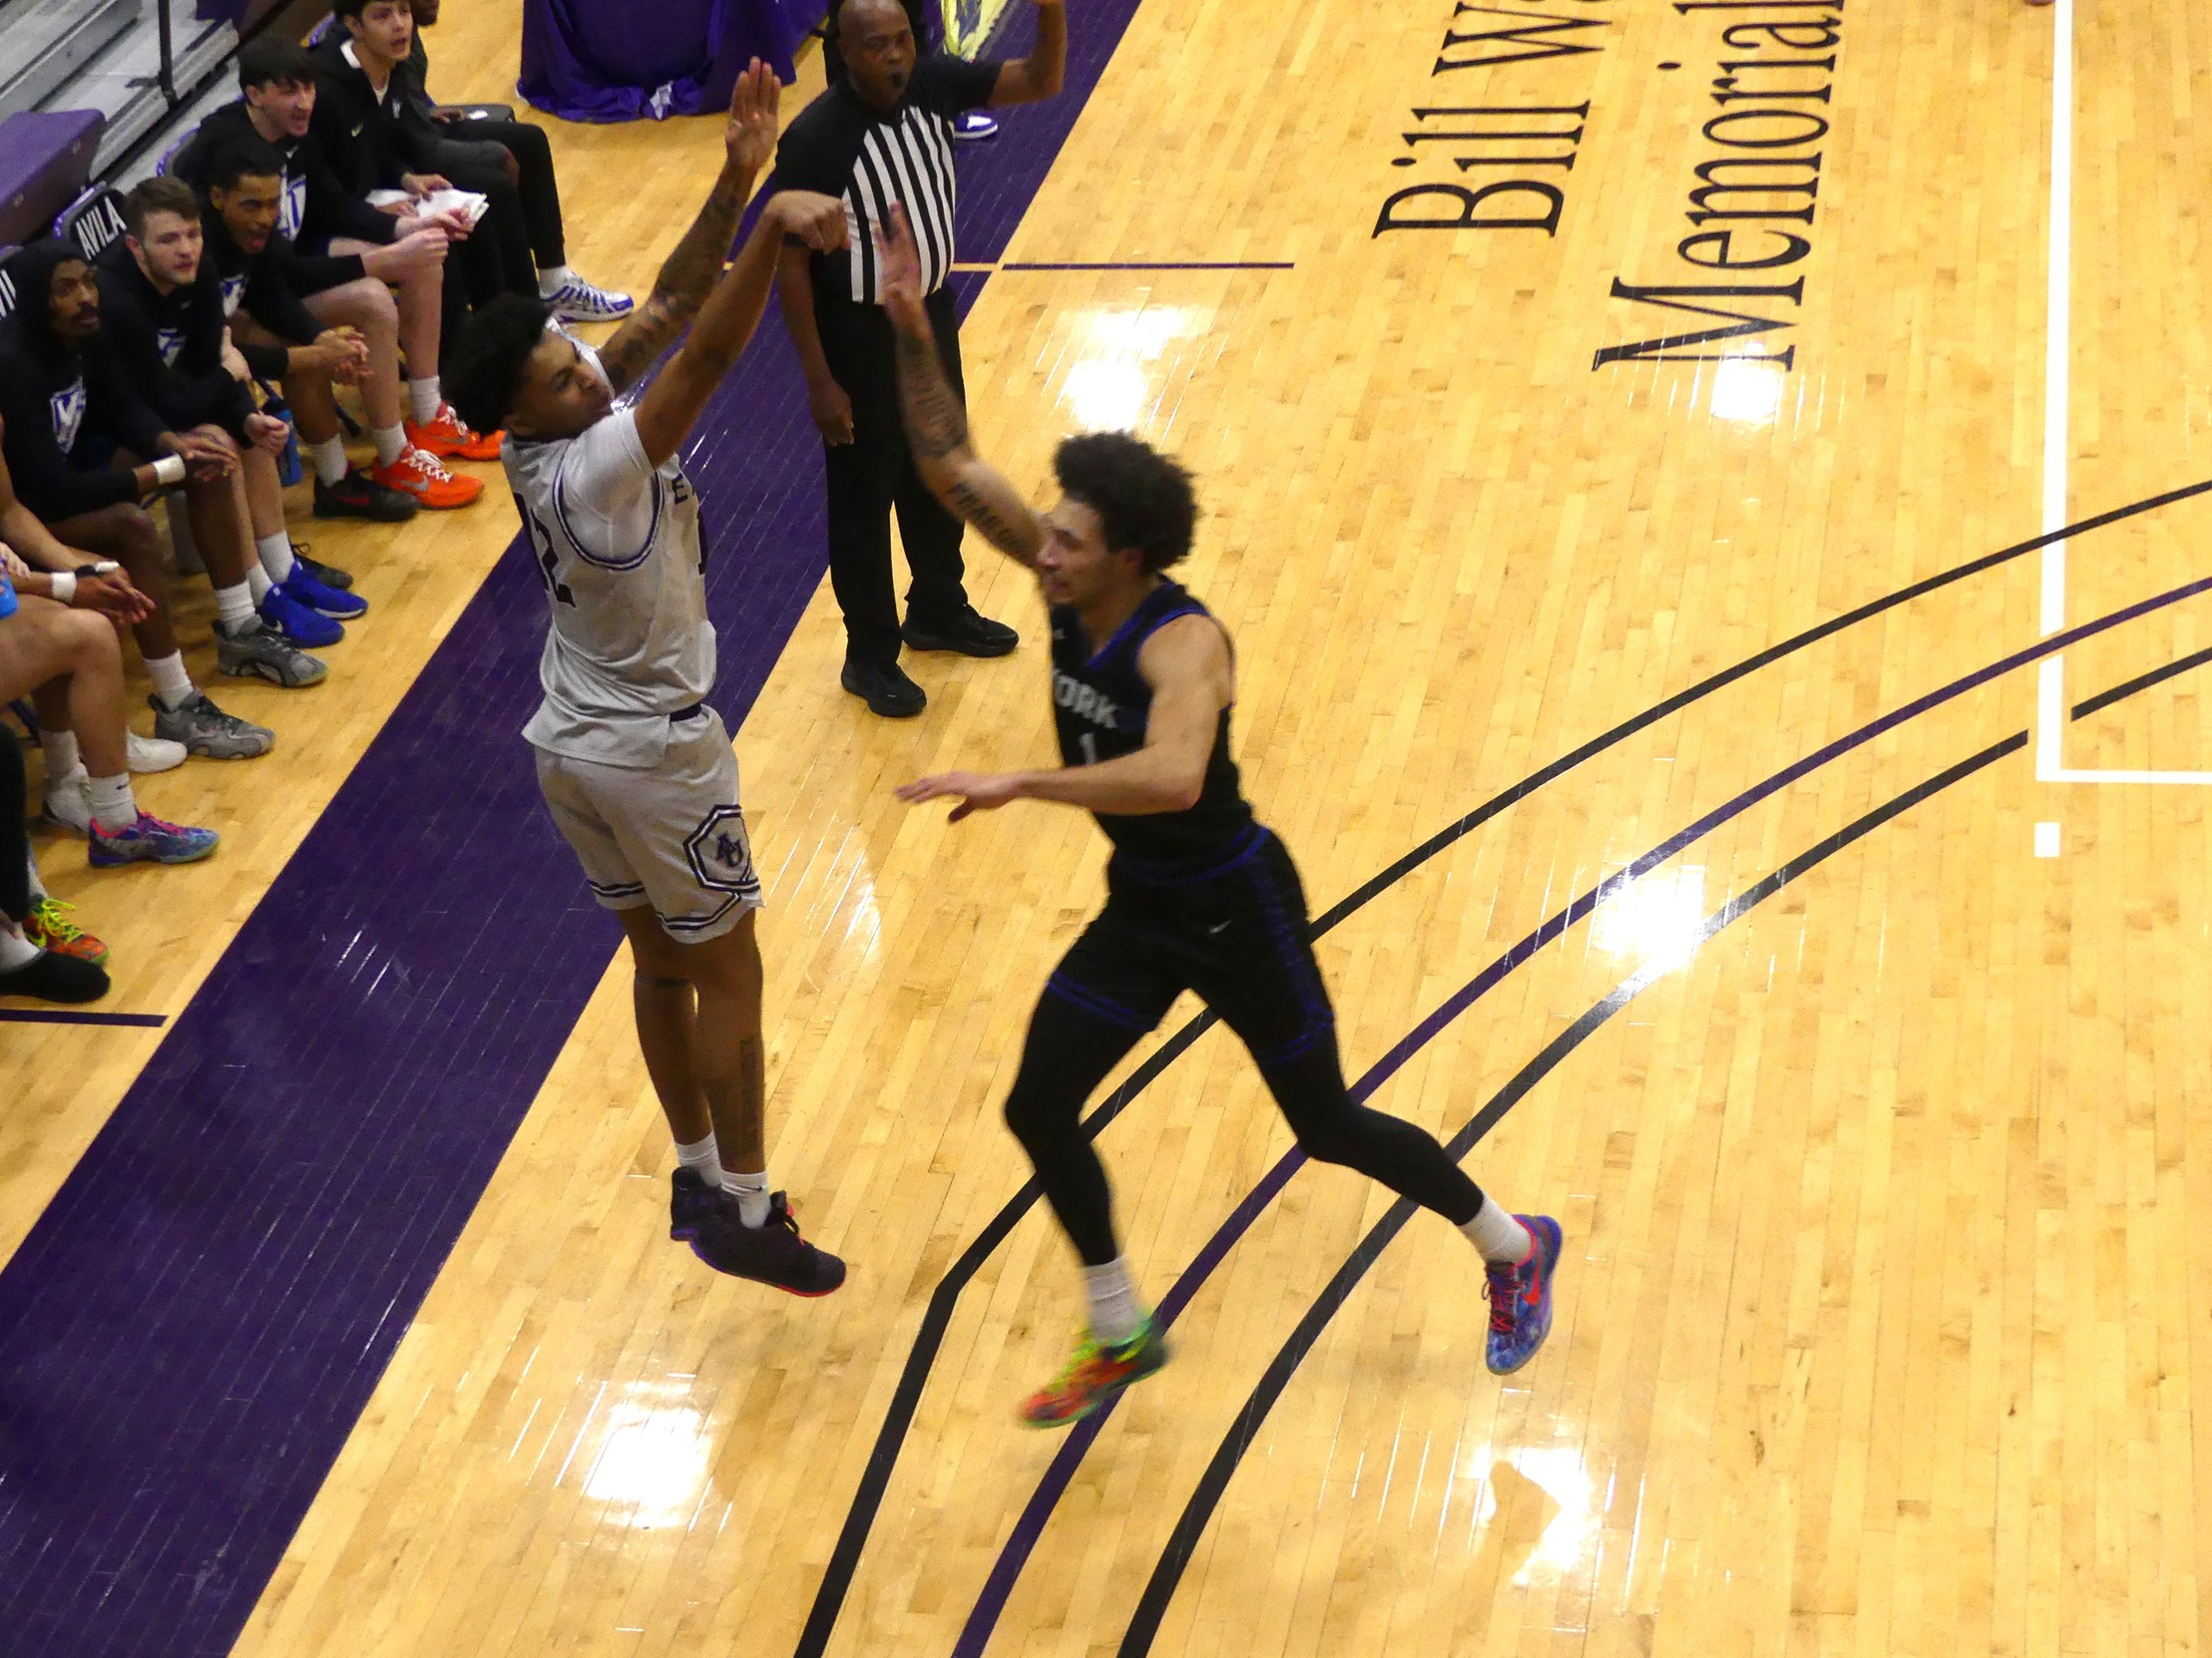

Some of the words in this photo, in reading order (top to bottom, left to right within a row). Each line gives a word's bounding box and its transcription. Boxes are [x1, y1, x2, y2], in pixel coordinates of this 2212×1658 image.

[1431, 0, 1613, 78] W
[1371, 99, 1591, 238] Bill
[1591, 0, 1845, 372] Memorial
[75, 195, 128, 261] AVILA
[1053, 667, 1118, 729] ORK
